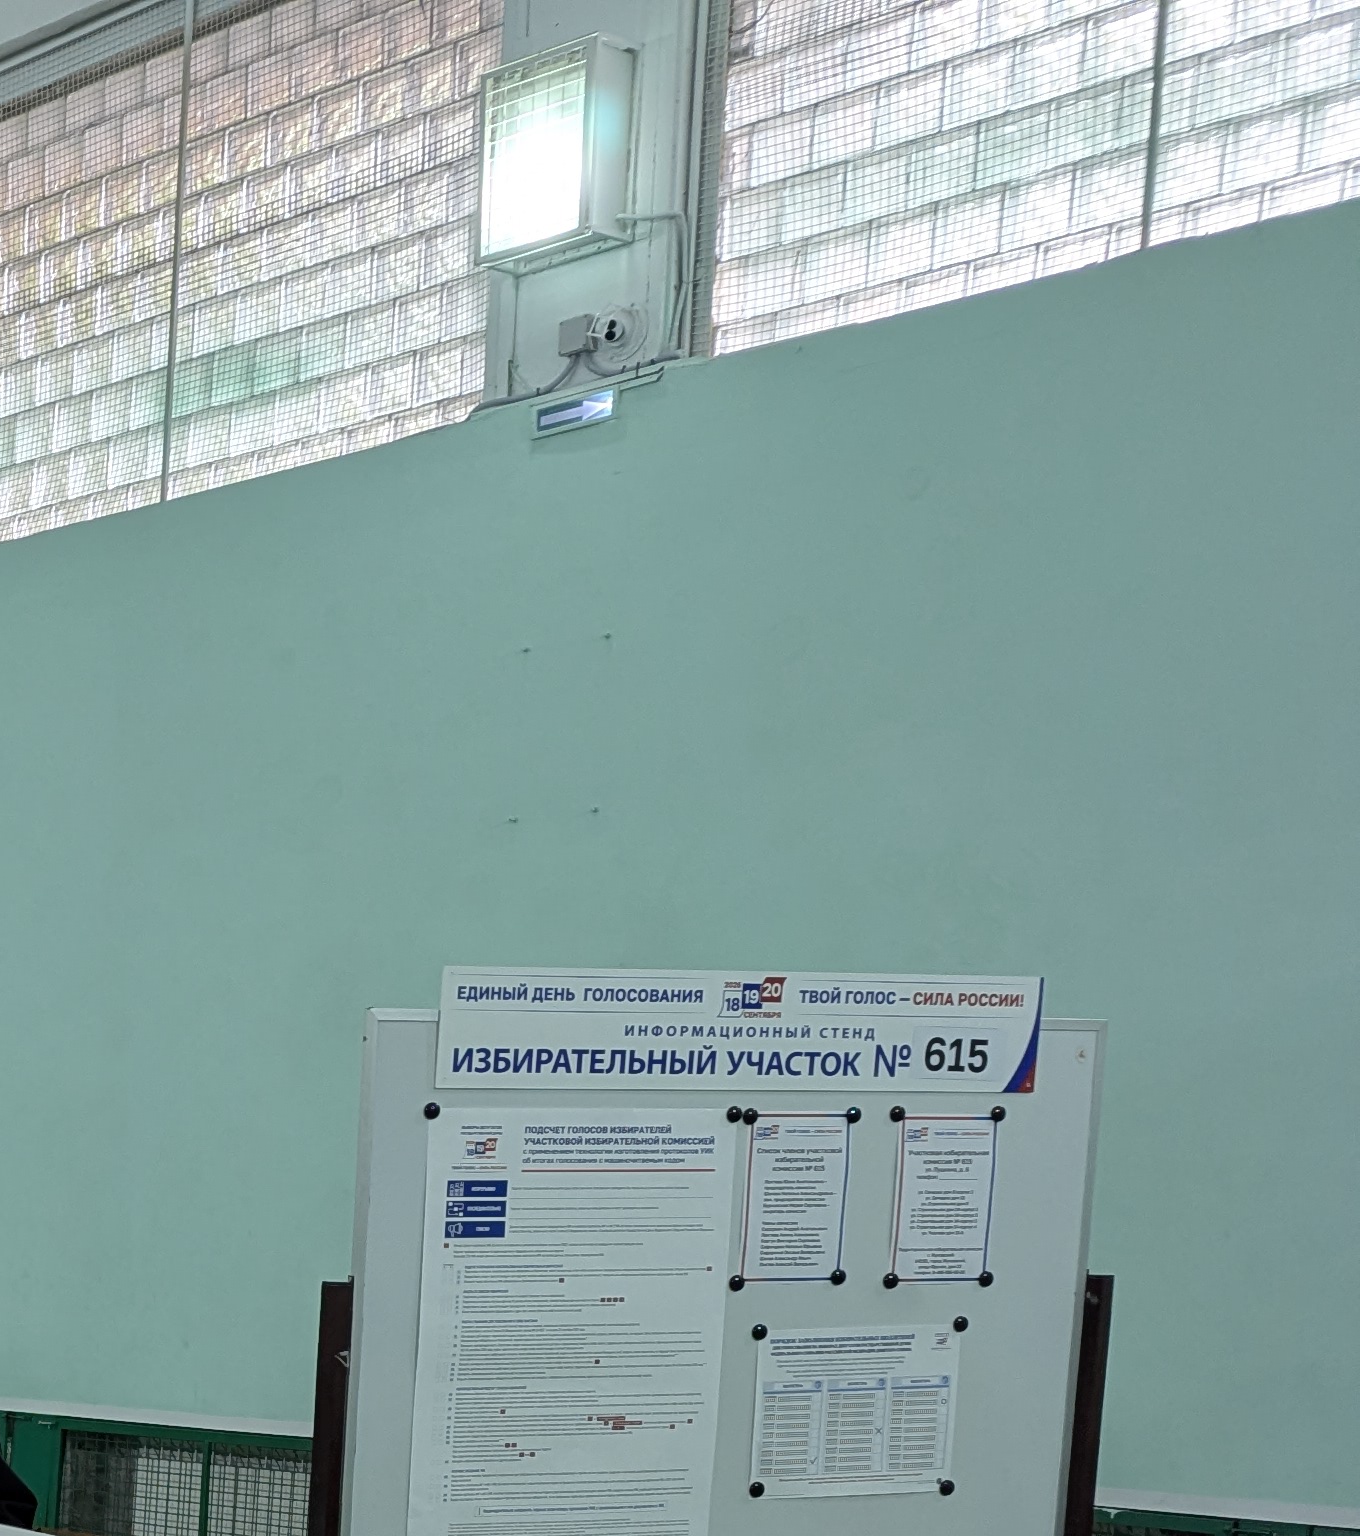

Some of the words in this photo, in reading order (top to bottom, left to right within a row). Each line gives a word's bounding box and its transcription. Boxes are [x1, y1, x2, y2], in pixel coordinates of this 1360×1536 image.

[456, 983, 528, 1003] ЕДИНЫЙ
[532, 986, 576, 1004] ДЕНЬ
[583, 987, 704, 1004] ГОЛОСОВАНИЯ
[725, 997, 740, 1012] 18
[744, 989, 760, 1004] 19
[761, 982, 782, 998] 20
[799, 986, 842, 1005] ТВОЙ
[845, 990, 896, 1006] ГОЛОС
[913, 991, 954, 1007] СИЛА
[957, 992, 1025, 1008] РОССИИ!
[624, 1023, 811, 1040] ИНФОРМАЦИОННЫЙ
[819, 1026, 876, 1042] СТЕНД
[451, 1044, 718, 1076] ИЗБИРАТЕЛЬНЫЙ
[726, 1050, 862, 1077] УЧАСТОК
[873, 1044, 912, 1078] №
[924, 1036, 989, 1074] 615
[524, 1126, 566, 1135] ПОДСЧЕТ
[567, 1126, 609, 1134] ГОЛОСОВ
[610, 1124, 672, 1134] ИЗБИРАТЕЛЕЙ
[523, 1135, 583, 1146] УЧАСТКОВОЙ
[661, 1135, 715, 1146] КОМИССИЕЙ
